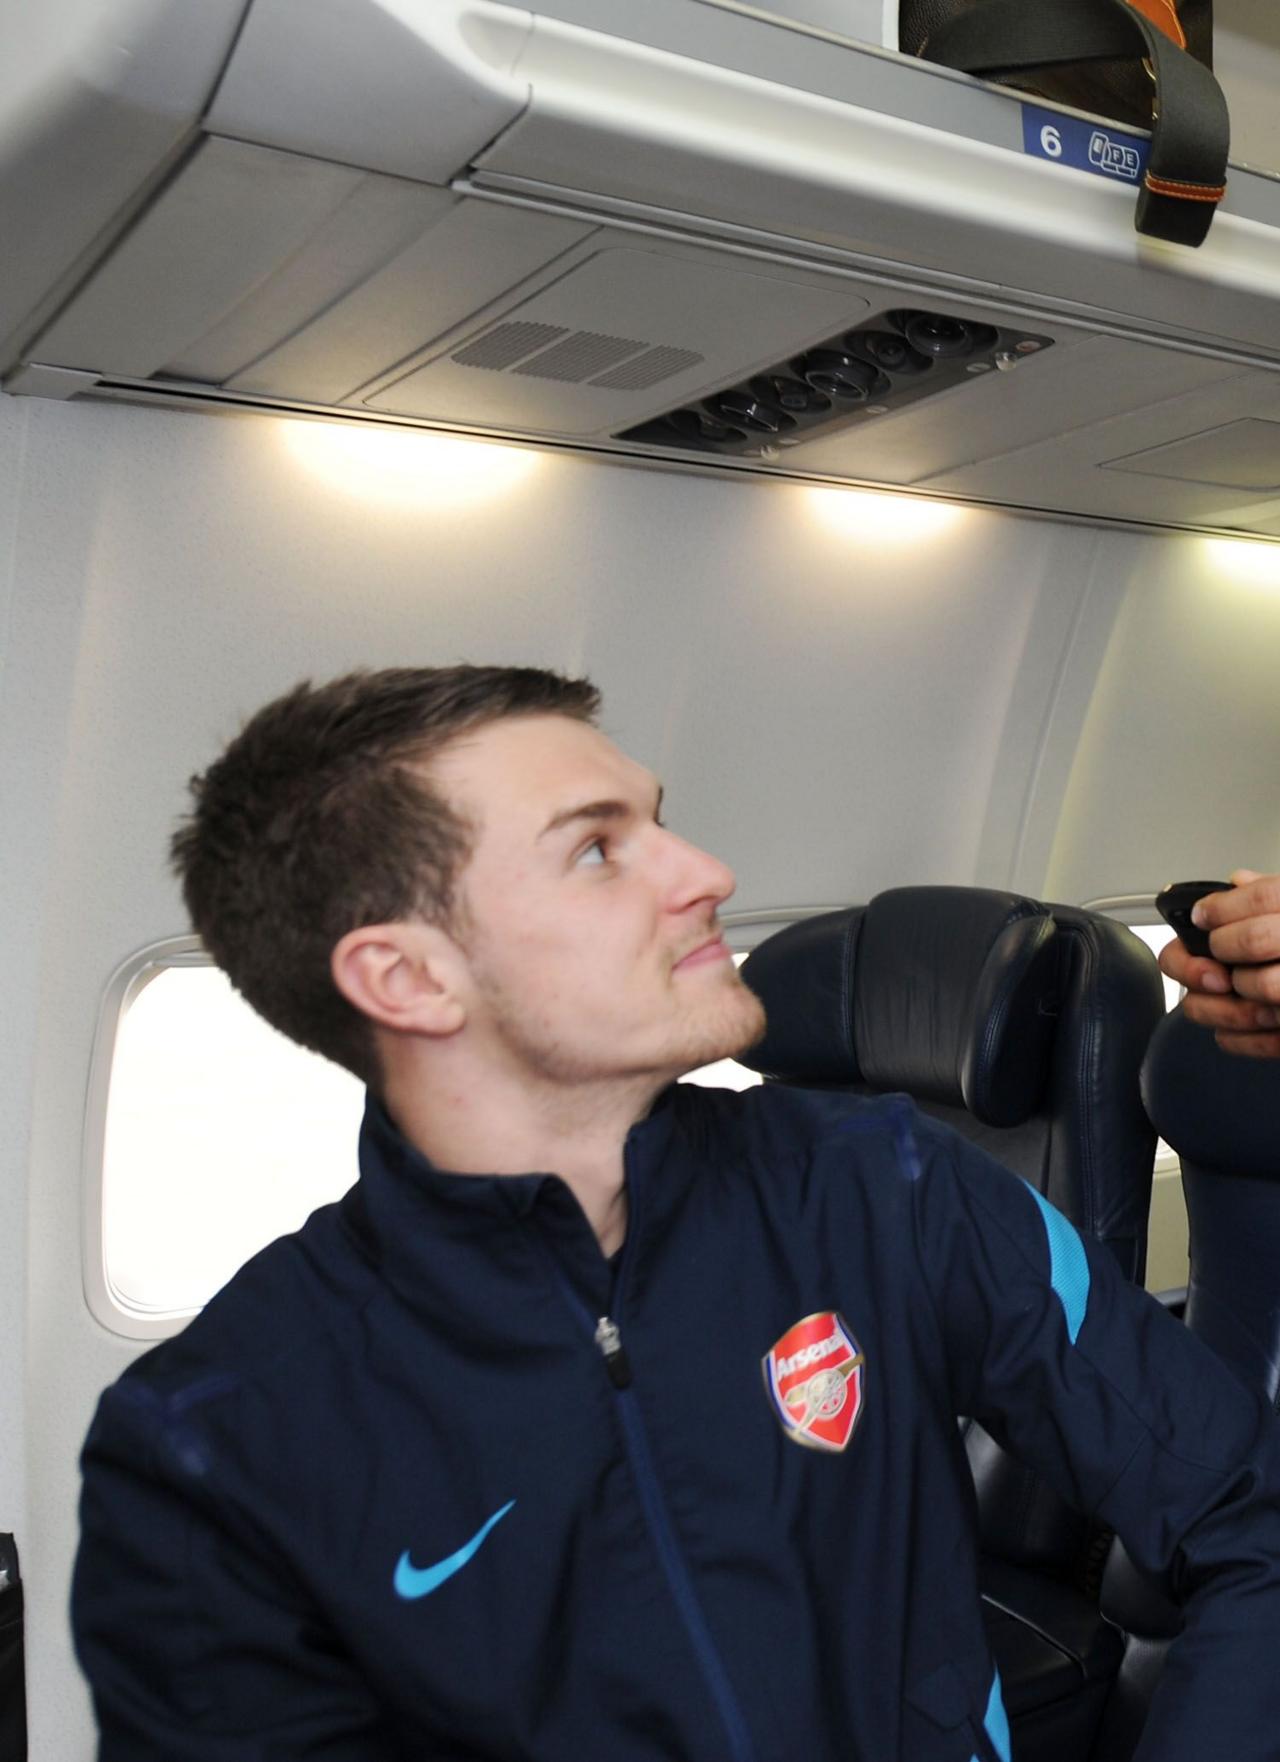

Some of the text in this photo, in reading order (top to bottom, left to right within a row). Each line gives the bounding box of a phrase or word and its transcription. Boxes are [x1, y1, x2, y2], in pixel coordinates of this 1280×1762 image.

[1040, 125, 1135, 166] 6 F E
[776, 1328, 847, 1380] Arsenal
